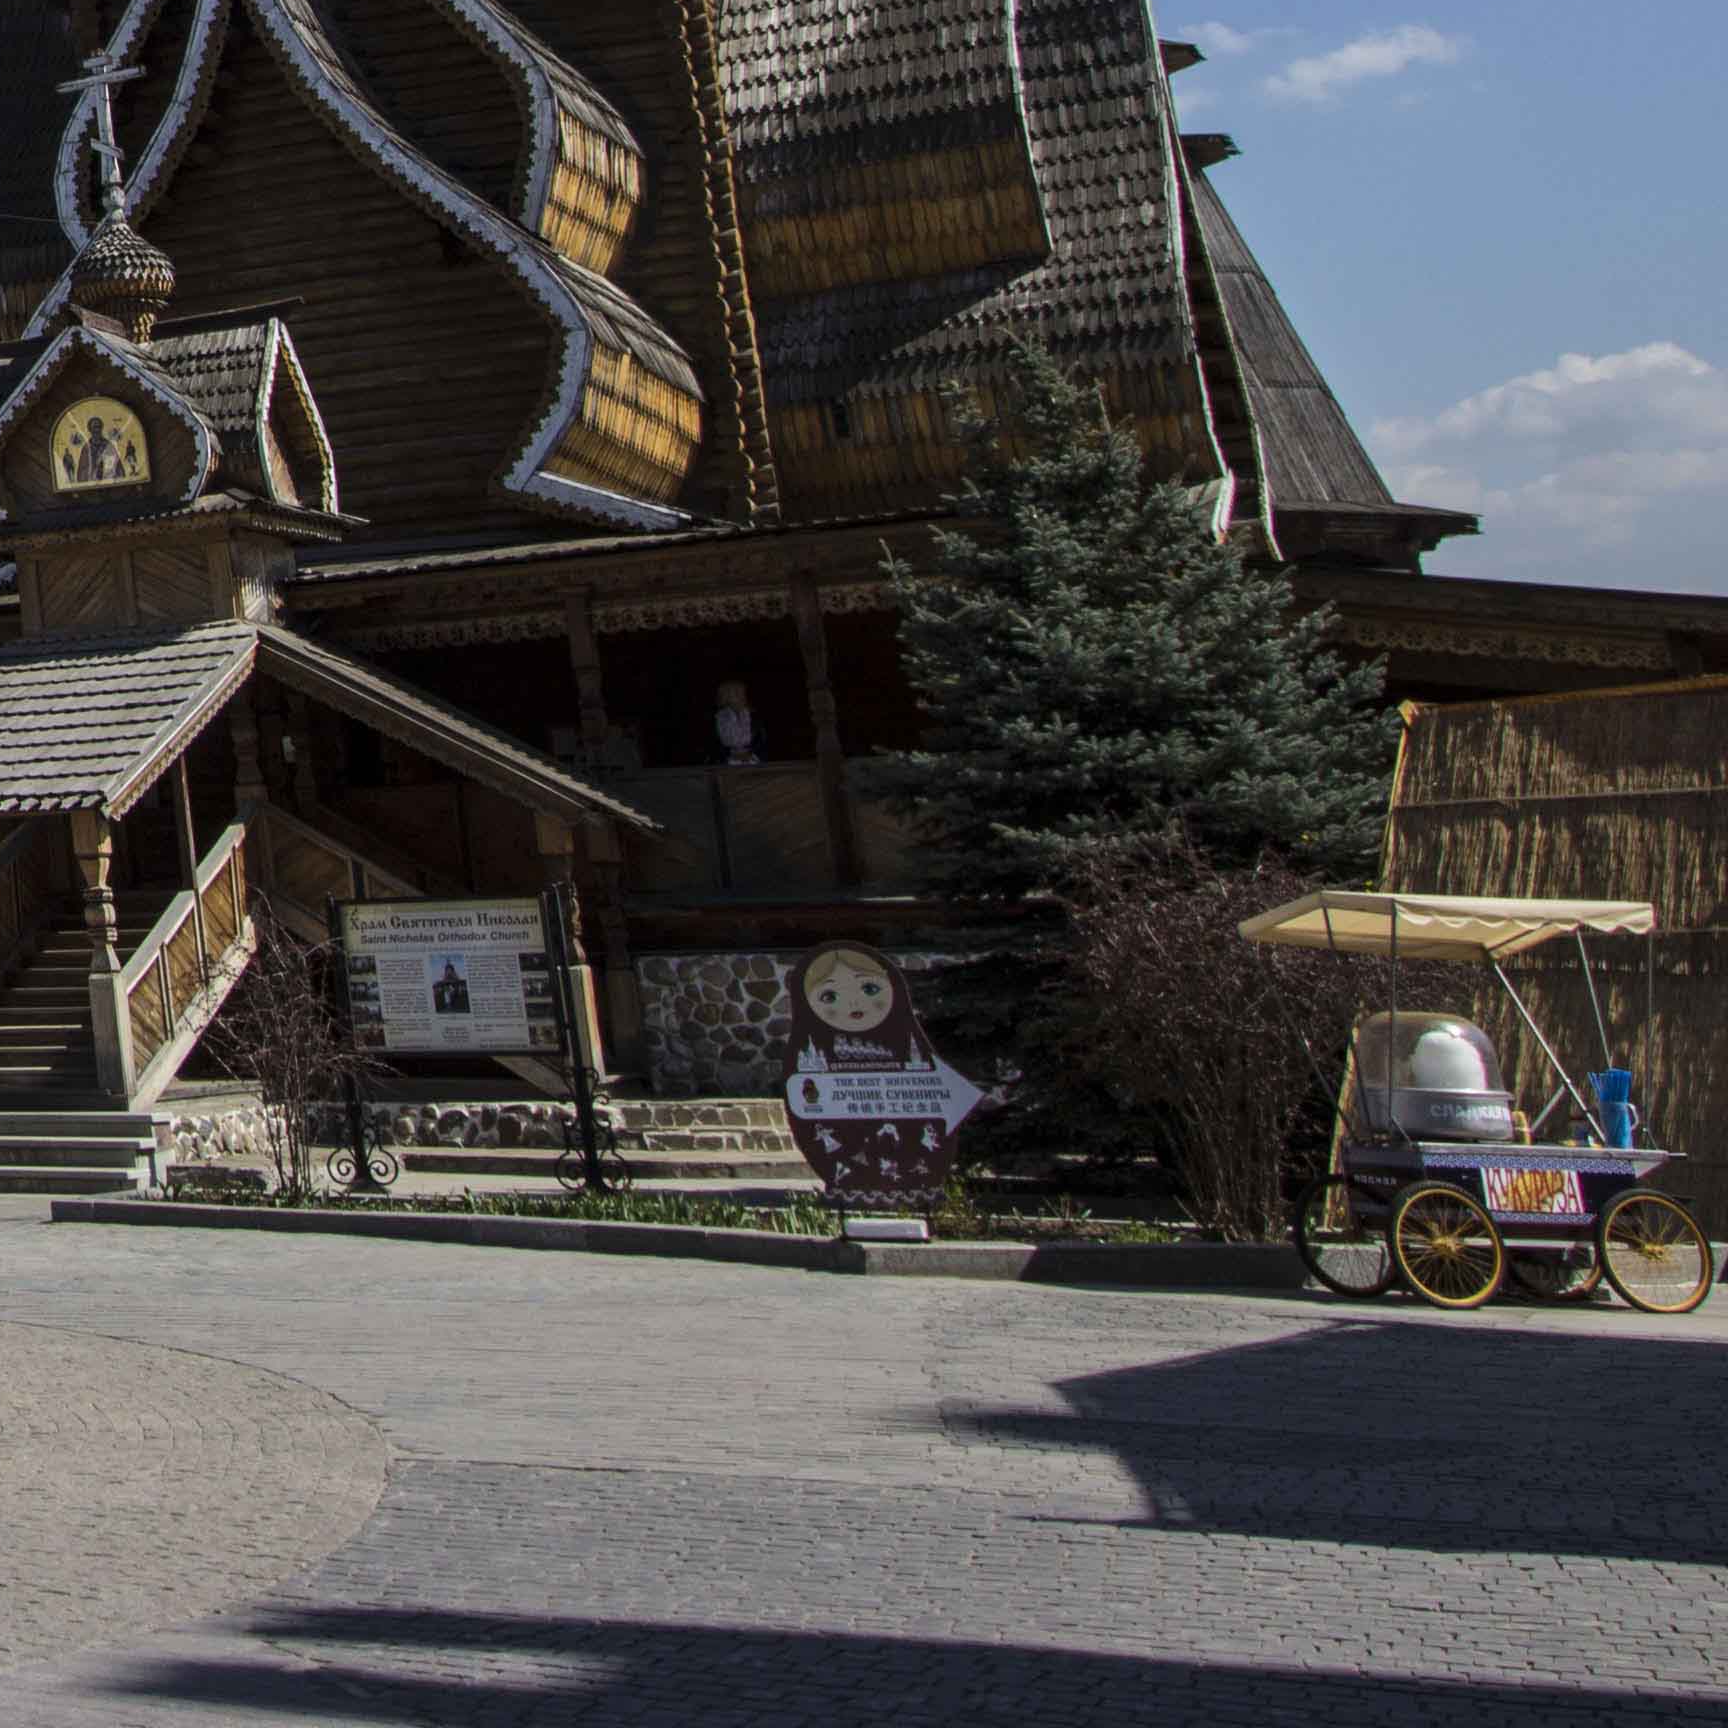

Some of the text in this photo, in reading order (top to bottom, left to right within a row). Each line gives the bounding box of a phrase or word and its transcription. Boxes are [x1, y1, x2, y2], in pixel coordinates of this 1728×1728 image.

[390, 914, 473, 929] Святителя
[476, 912, 538, 926] Николая
[361, 930, 529, 944] Saint Nicholas Orthodox Church
[834, 1076, 943, 1086] THE BEST SOUVENIRS
[832, 1088, 951, 1101] ЛУЧШИЕ СУВЕНИРЫ
[1487, 1167, 1580, 1212] КУКУРУЗА
